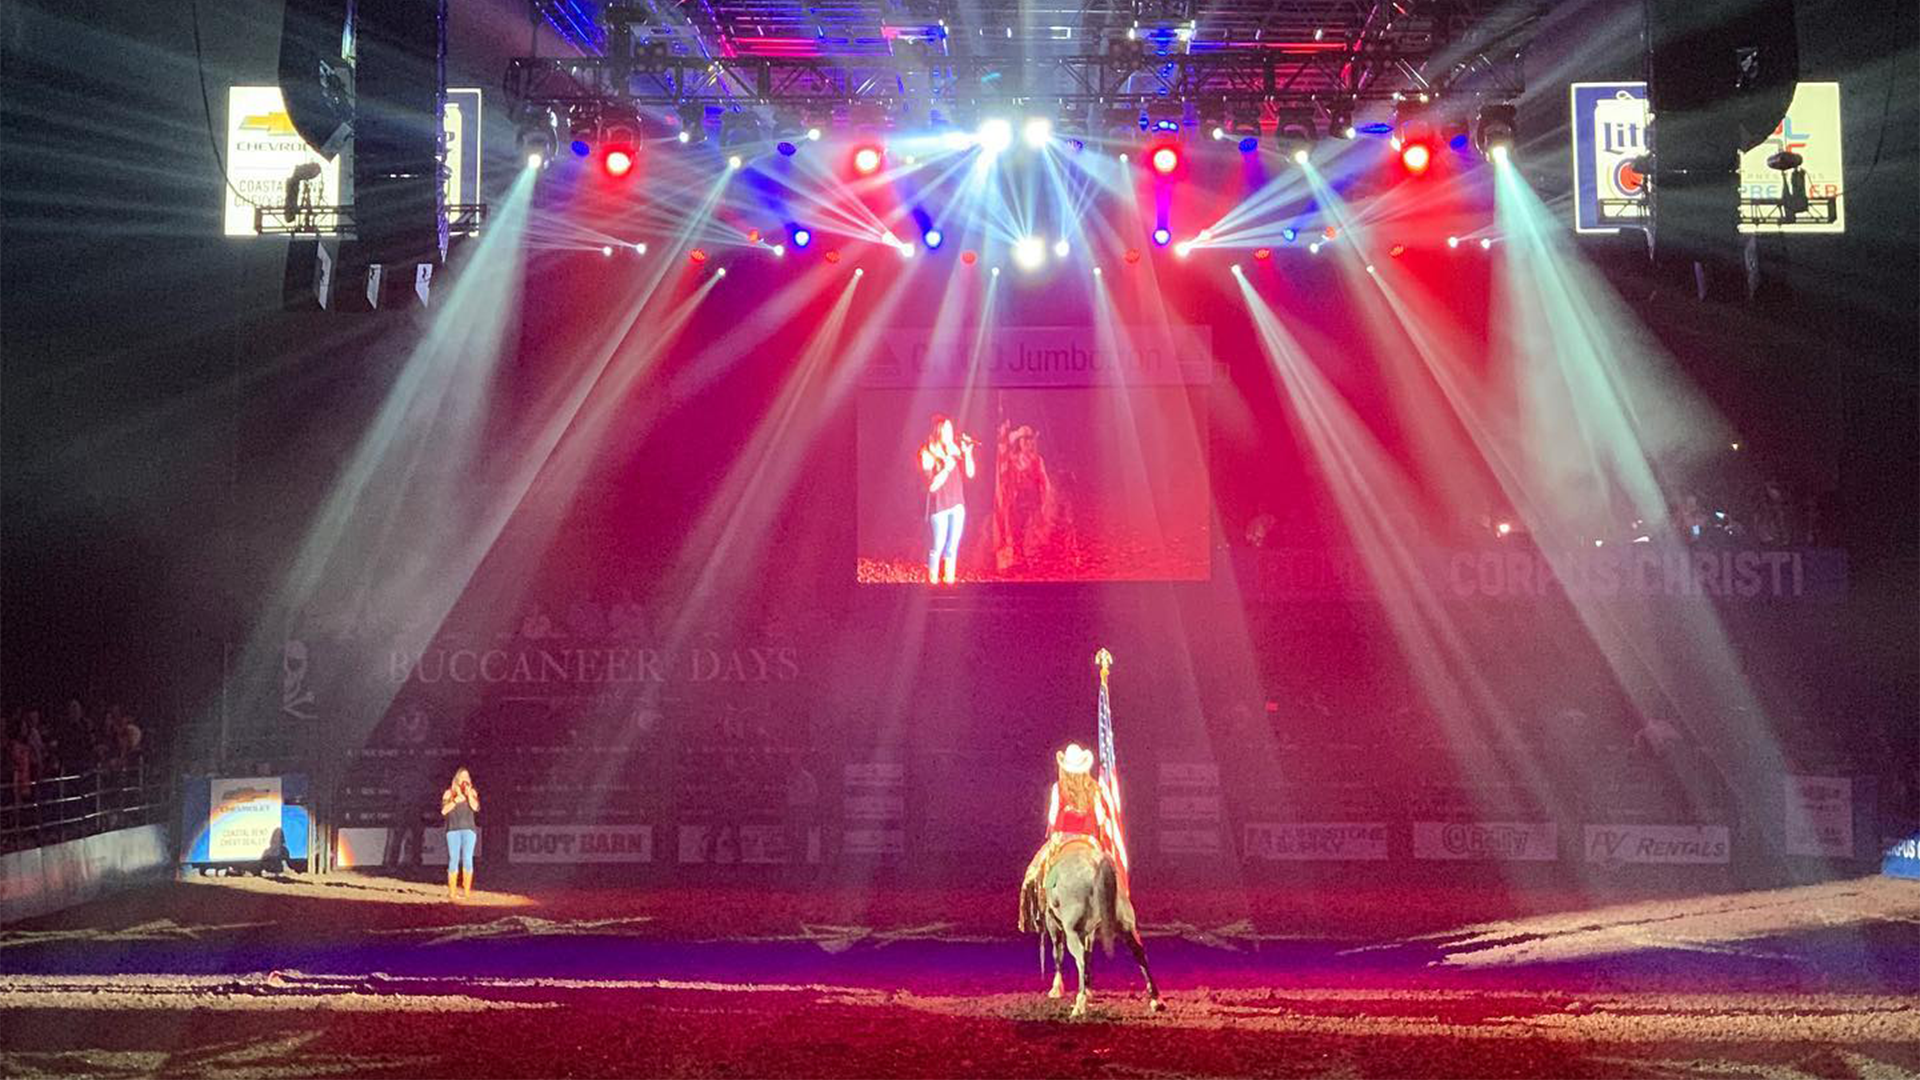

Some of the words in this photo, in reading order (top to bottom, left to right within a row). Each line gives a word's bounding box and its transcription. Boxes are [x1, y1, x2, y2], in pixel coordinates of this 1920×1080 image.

[239, 180, 284, 193] COASTA
[1450, 551, 1620, 597] CORPUS
[1635, 549, 1804, 597] CHRISTI
[388, 647, 665, 683] BUCCANEER
[690, 646, 799, 681] DAYS
[511, 832, 576, 855] BOOT
[579, 832, 643, 855] BARN
[1636, 837, 1726, 857] RENTALS
